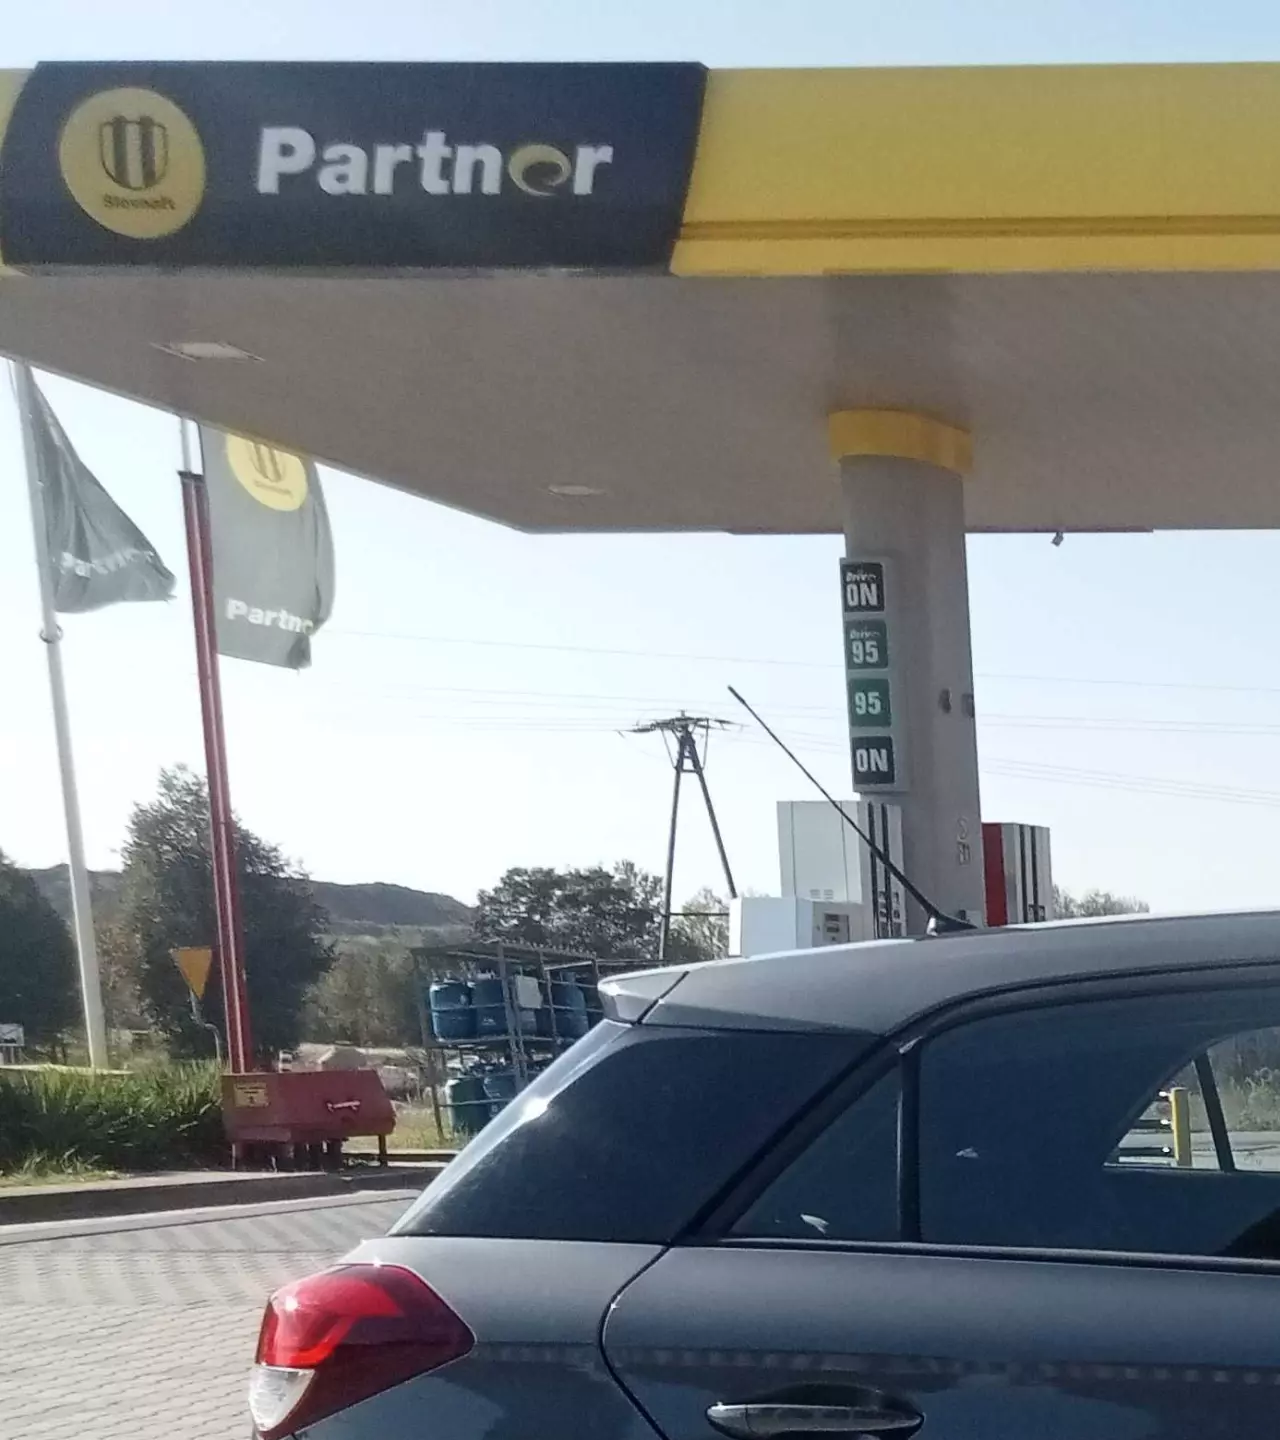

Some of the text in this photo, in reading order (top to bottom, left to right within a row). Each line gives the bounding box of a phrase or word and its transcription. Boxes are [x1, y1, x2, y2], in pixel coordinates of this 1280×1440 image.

[256, 125, 614, 197] Partner
[852, 640, 879, 665] 95
[855, 691, 882, 715] 95
[856, 748, 888, 772] ON
